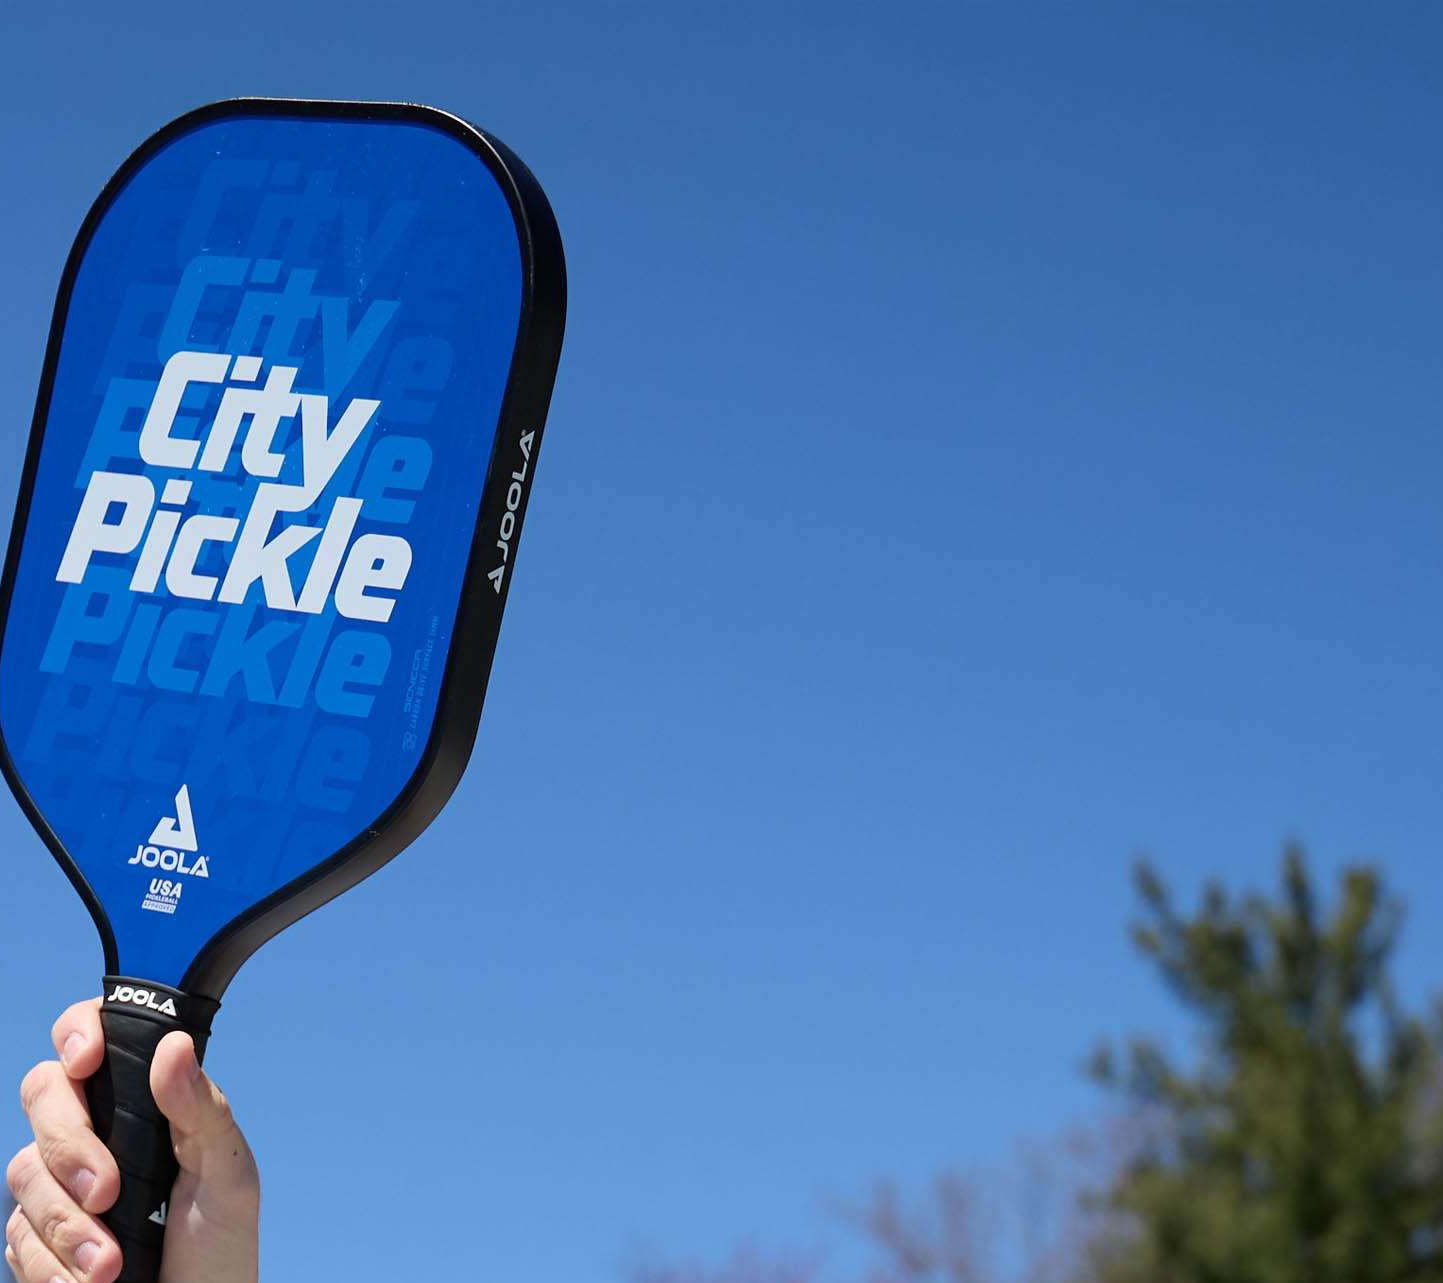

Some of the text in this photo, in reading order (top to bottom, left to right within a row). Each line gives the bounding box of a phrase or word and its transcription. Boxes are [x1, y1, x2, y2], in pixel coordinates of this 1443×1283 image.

[138, 350, 381, 512] City
[497, 430, 536, 563] JOOLA
[55, 470, 413, 623] Pickle
[38, 567, 392, 719] Pickle
[127, 844, 210, 878] JOOLA
[149, 877, 182, 899] USA
[107, 984, 177, 1018] JOOLA
